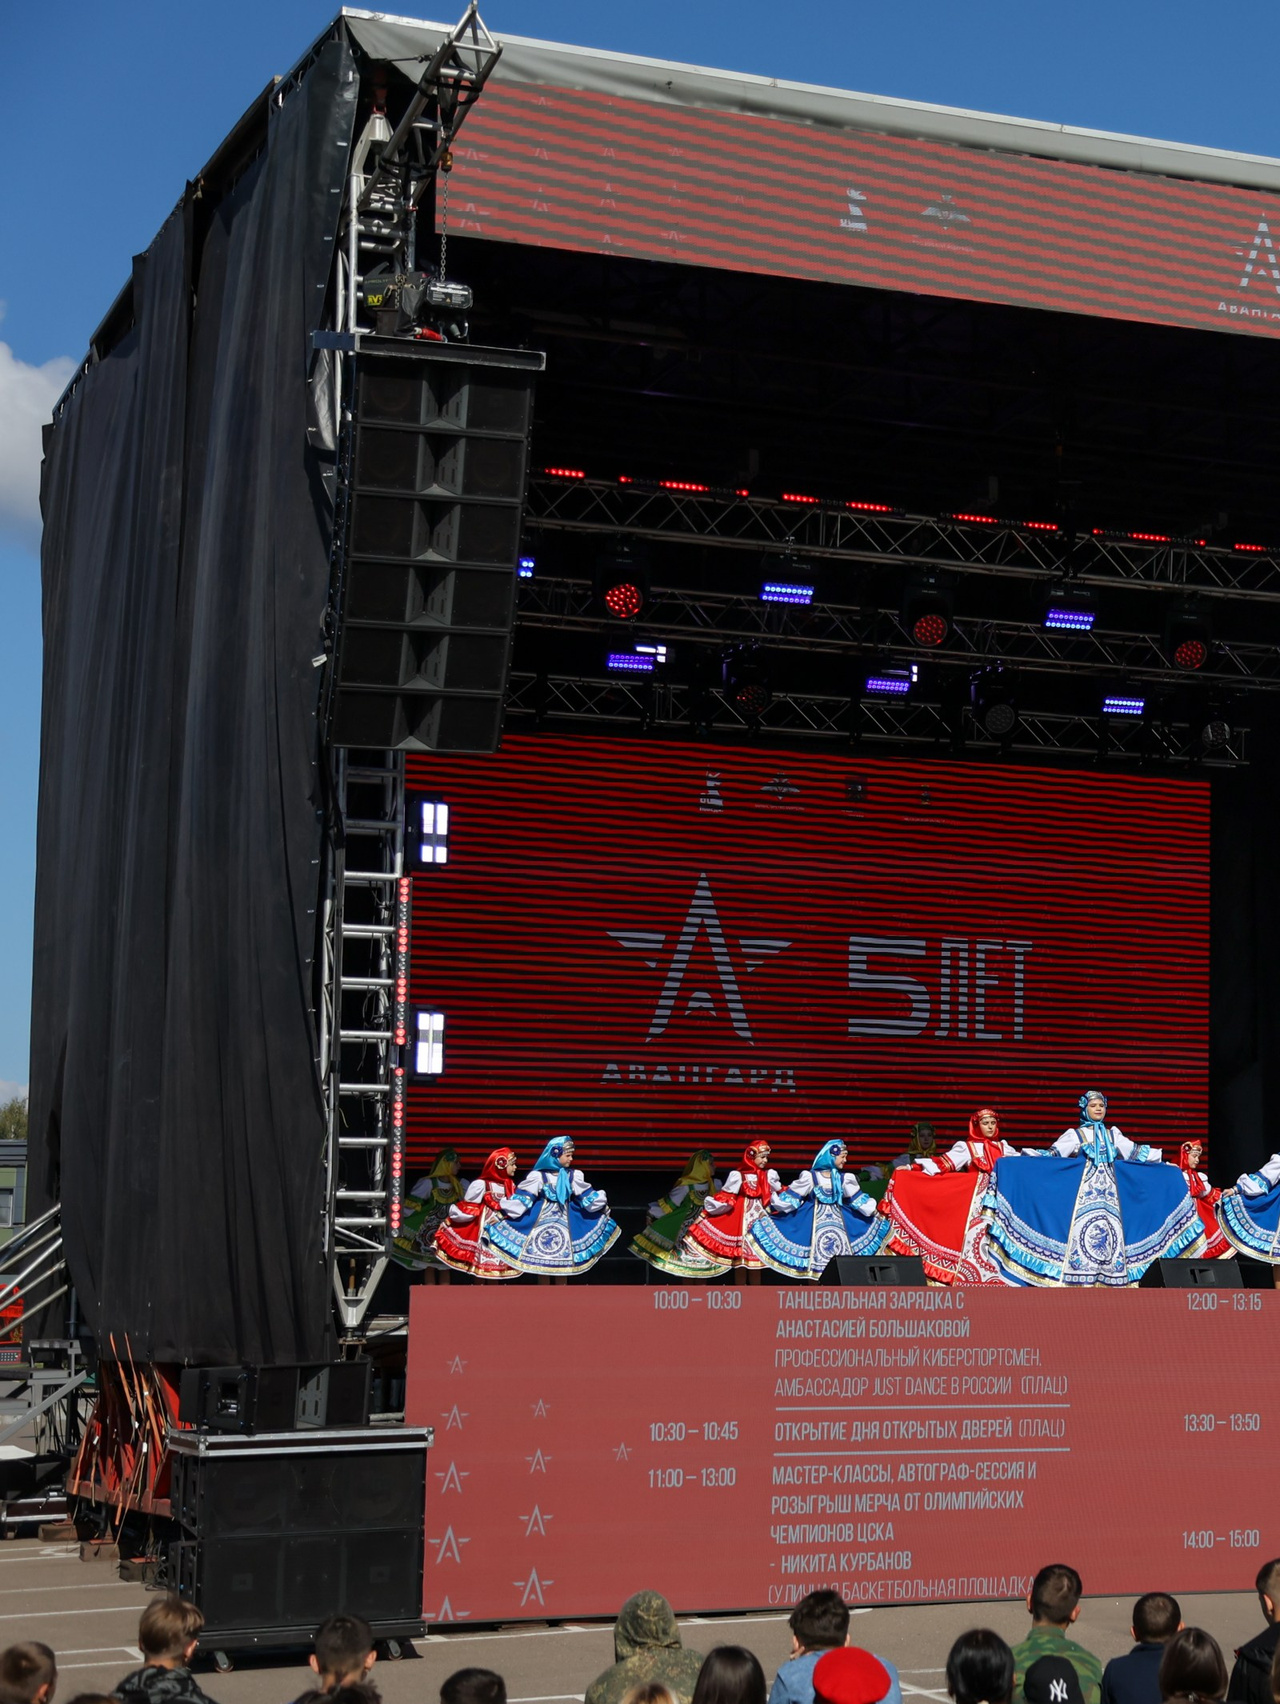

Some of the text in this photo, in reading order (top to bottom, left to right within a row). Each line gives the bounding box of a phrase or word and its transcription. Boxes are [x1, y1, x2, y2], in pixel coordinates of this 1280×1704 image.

[654, 1290, 689, 1310] 10:00
[706, 1290, 741, 1310] 10:30
[778, 1291, 964, 1311] ТАНЦЕВАЛЬНАЯ ЗАРЯДКА С
[1187, 1293, 1217, 1311] 12:00
[1233, 1293, 1261, 1311] 13:15
[776, 1316, 970, 1338] АНАСТАСИЕЙ БОЛЬШАКОВОЙ
[775, 1345, 919, 1367] ПРОФЕССИОНАЛЬНЫЙ
[774, 1375, 1068, 1398] АМБАССАДОР JUST DANCE В РОССИИ (ПЛАЦ)
[649, 1422, 685, 1442] 10:30
[702, 1421, 738, 1441] 10:45
[775, 1417, 1065, 1443] ОТКРЫТИЕ ДНЯ ОТКРЫТЫХ ДВЕРЕЙ (ПЛАЦ)
[1184, 1414, 1215, 1431] 13:30
[1230, 1414, 1260, 1431] 13:50
[648, 1468, 683, 1488] 11:00
[700, 1467, 736, 1487] 13:00
[773, 1461, 1036, 1485] МАСТЕР-КЛАССЫ, АВТОГРАФ-СЕССИЯ И
[771, 1488, 1024, 1514] РОЗЫГРЫШ МЕРЧА ОТ ОЛИМПИЙСКИХ
[770, 1523, 894, 1544] ЧЕМПИОНОВ ЦСКА
[1182, 1531, 1213, 1548] 14:00
[1229, 1530, 1259, 1547] 15:00
[781, 1553, 836, 1574] НИКИТА
[840, 1551, 912, 1572] КУРБАНОВ
[842, 1578, 955, 1600] БАСКЕТБОЛЬНАЯ
